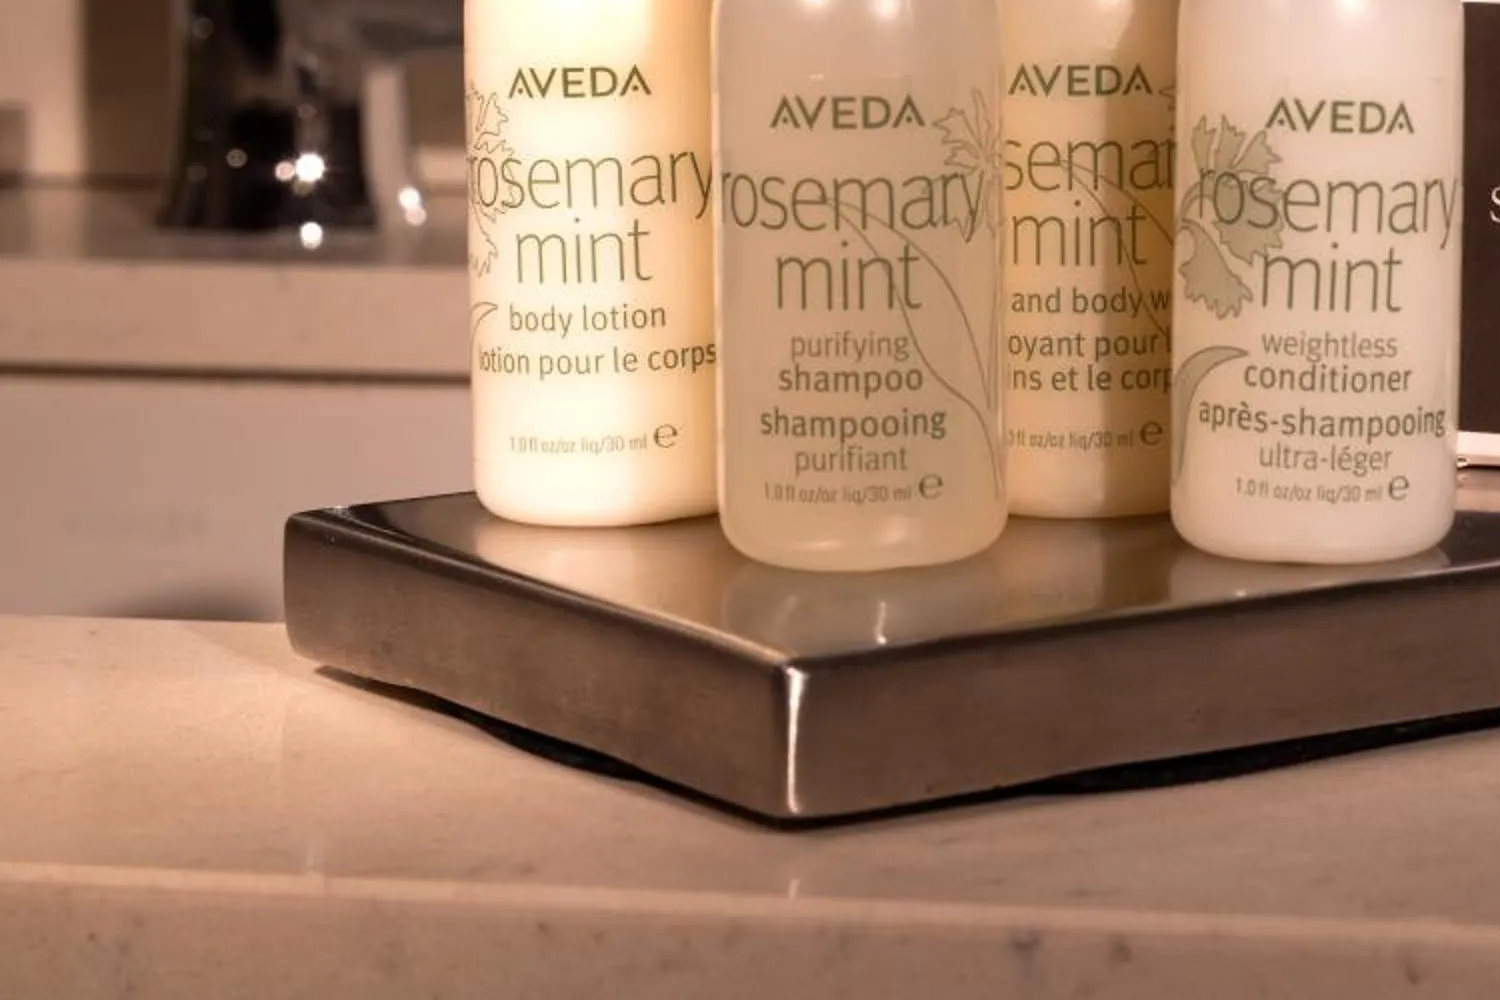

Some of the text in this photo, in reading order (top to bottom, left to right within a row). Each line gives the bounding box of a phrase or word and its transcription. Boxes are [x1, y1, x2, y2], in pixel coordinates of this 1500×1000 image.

[508, 65, 652, 98] AVEDA
[1009, 64, 1153, 96] AVEDA
[770, 94, 925, 130] AVEDA
[1265, 97, 1415, 134] AVEDA
[722, 169, 984, 244] rosemary
[1199, 167, 1458, 250] rosemary
[1012, 200, 1147, 266] mint
[516, 219, 653, 284] mint
[776, 241, 922, 310] mint
[1262, 242, 1402, 312] mint
[1011, 286, 1061, 313] and
[1072, 286, 1143, 318] body
[510, 303, 667, 338] body lotion
[540, 353, 605, 381] pour
[613, 346, 638, 373] le
[648, 343, 717, 373] corps
[791, 331, 909, 362] purifying
[1008, 332, 1086, 361] oyant
[1096, 333, 1160, 363] pour
[1262, 332, 1398, 362] weightless
[778, 367, 923, 398] shampoo
[1052, 367, 1080, 391] et
[1088, 364, 1112, 391] le
[1244, 362, 1412, 393] conditioner
[760, 408, 947, 442] shampooing
[1199, 401, 1446, 445] après-shampooing
[795, 446, 907, 476] purifiant
[1259, 440, 1392, 477] ultra-léger
